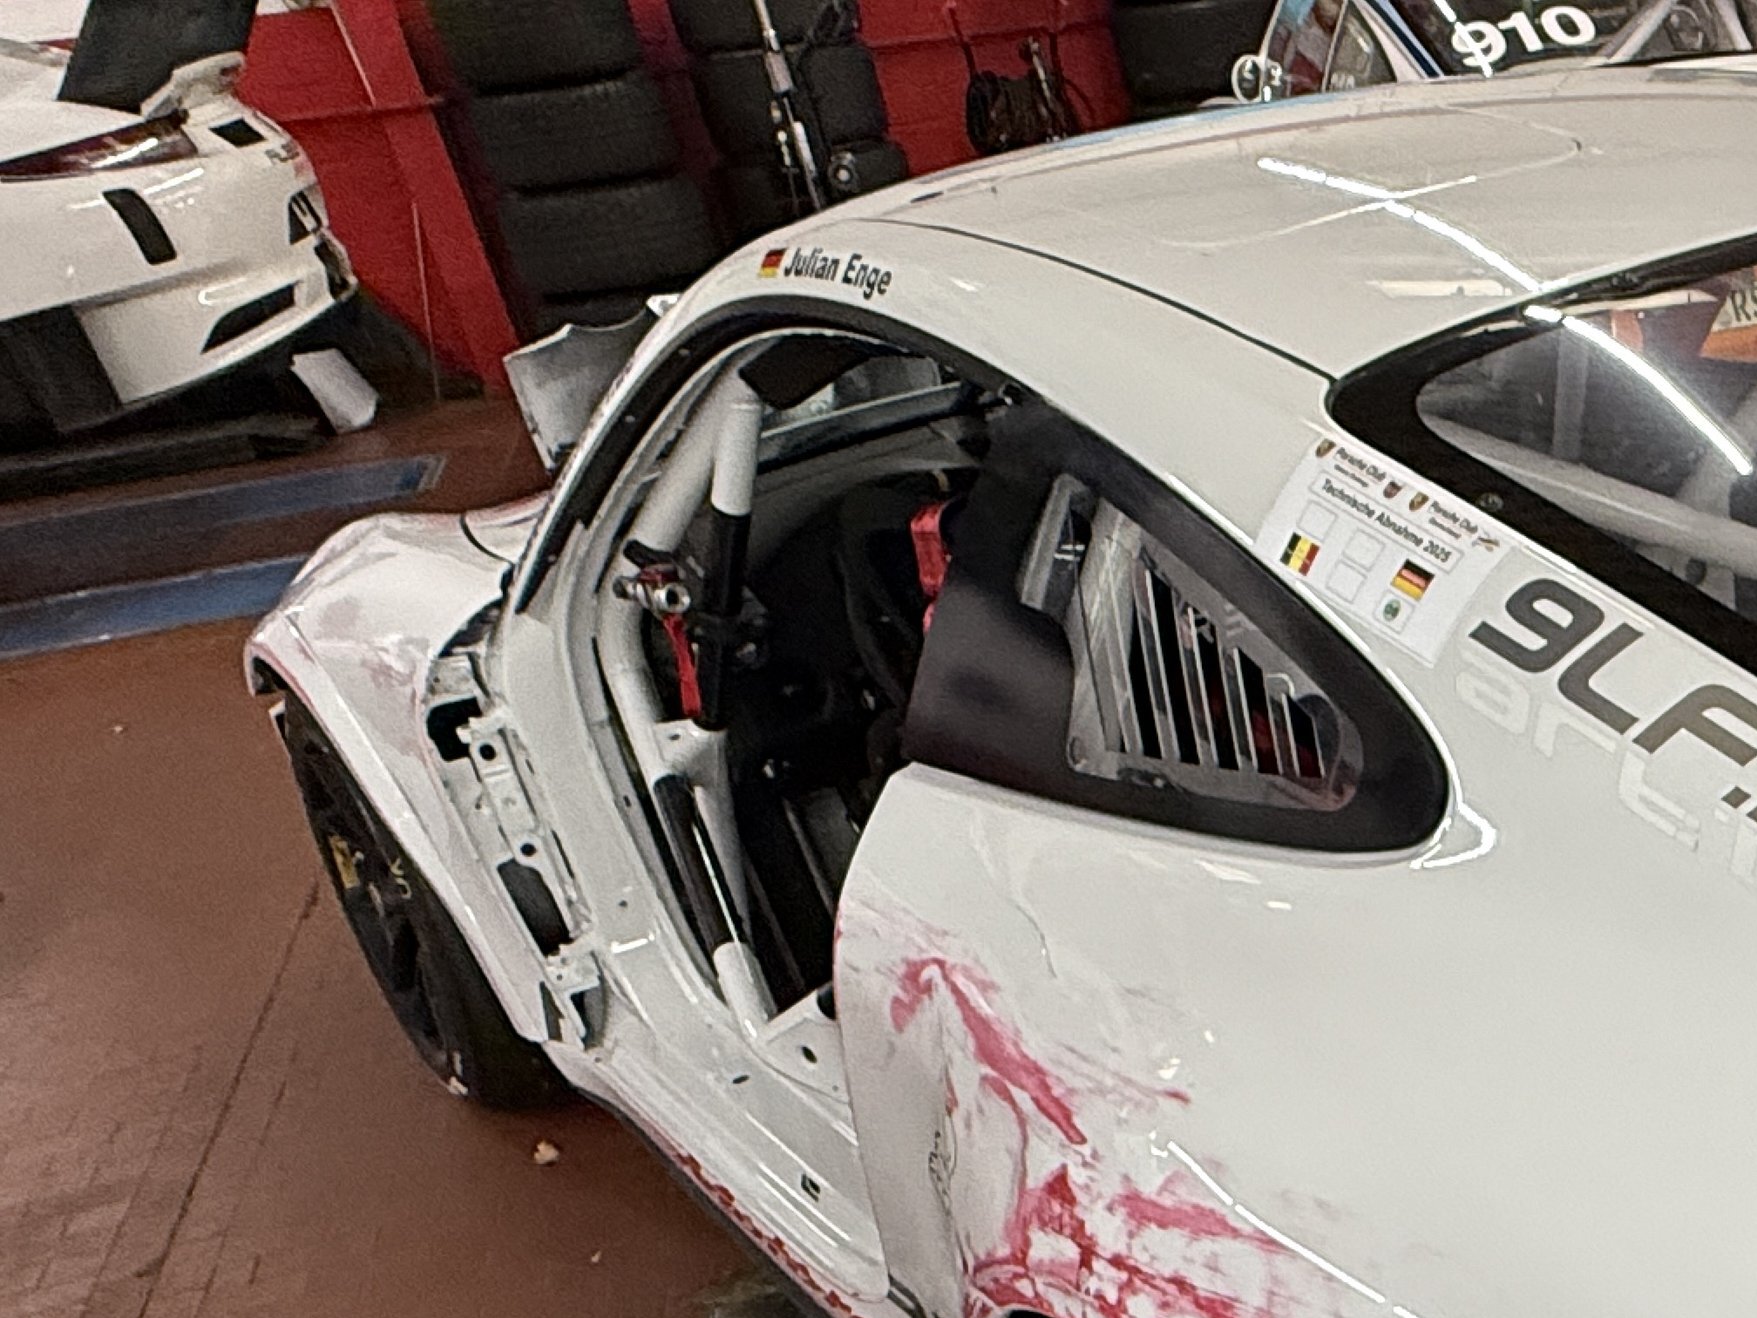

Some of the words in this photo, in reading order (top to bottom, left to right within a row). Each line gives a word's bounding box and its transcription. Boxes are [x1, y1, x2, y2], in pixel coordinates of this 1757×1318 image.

[1450, 5, 1597, 68] 910
[784, 246, 840, 282] Julian
[841, 252, 893, 301] Enge
[1321, 478, 1376, 518] Technische
[1375, 511, 1424, 547] Abnahme
